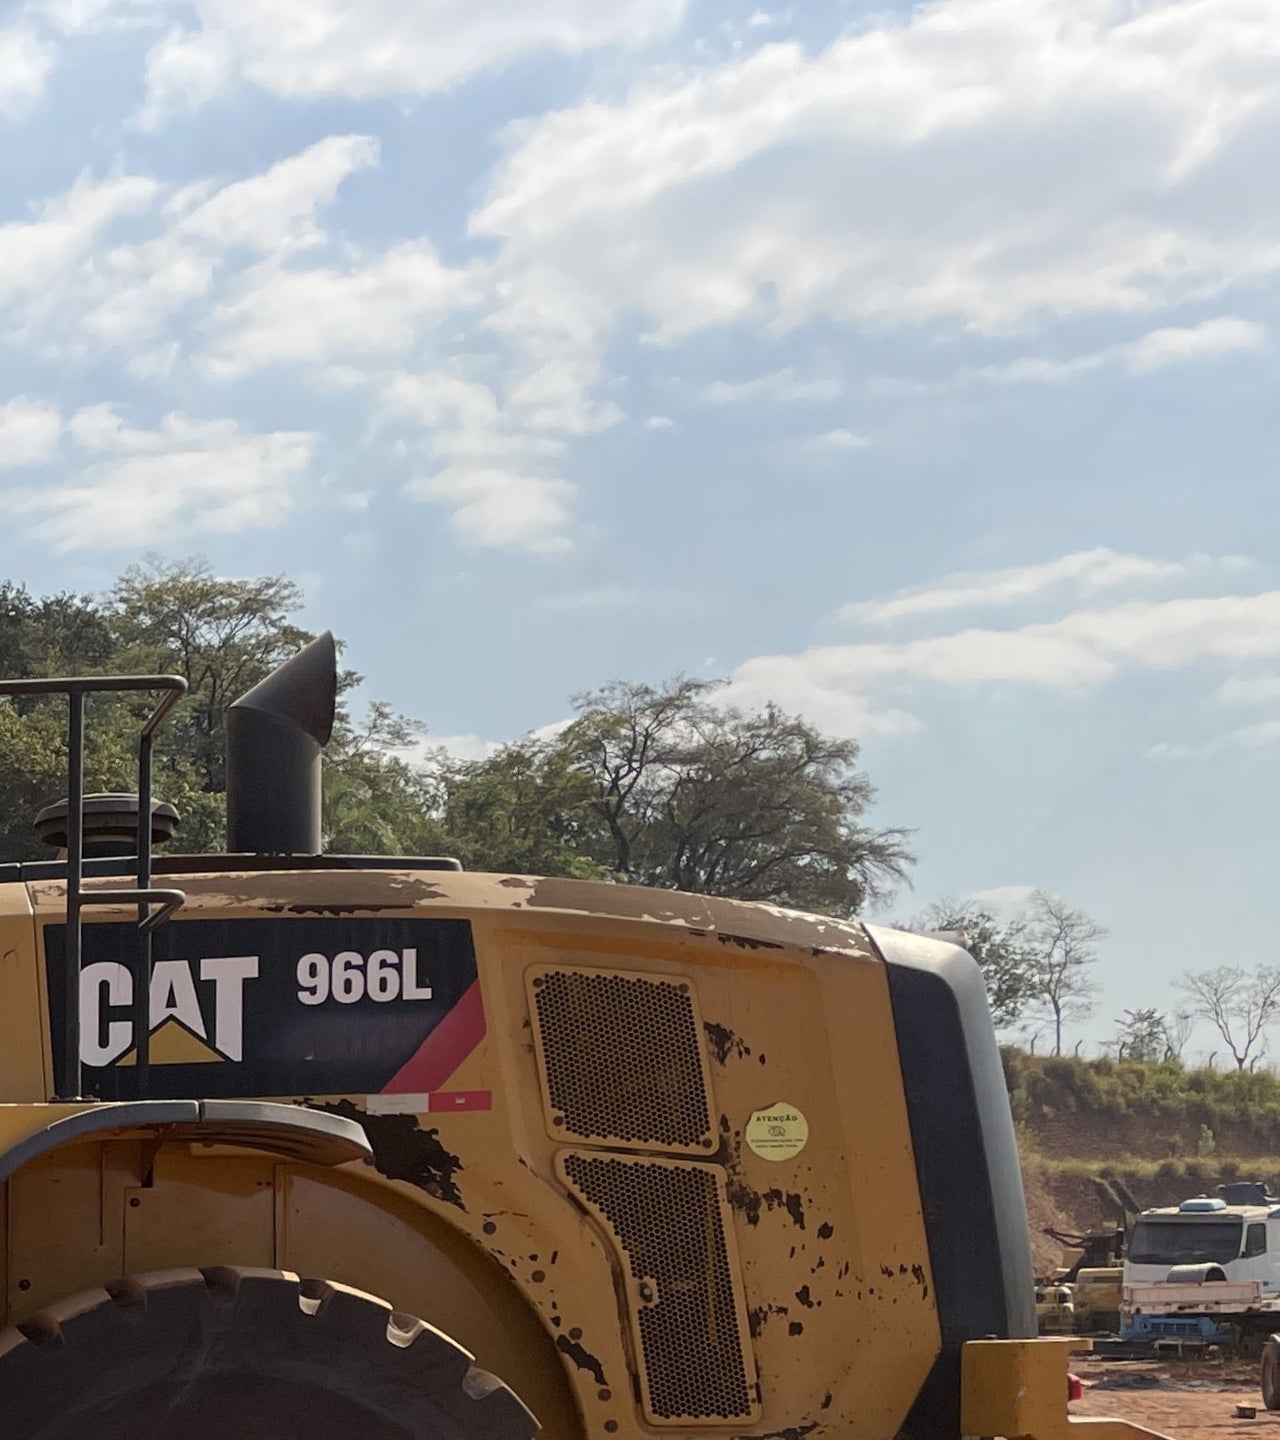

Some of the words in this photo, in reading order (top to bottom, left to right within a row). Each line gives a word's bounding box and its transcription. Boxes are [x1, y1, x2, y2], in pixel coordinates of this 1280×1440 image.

[78, 955, 260, 1067] CAT
[296, 948, 433, 1005] 966L
[756, 1115, 798, 1123] ATENÇÃO
